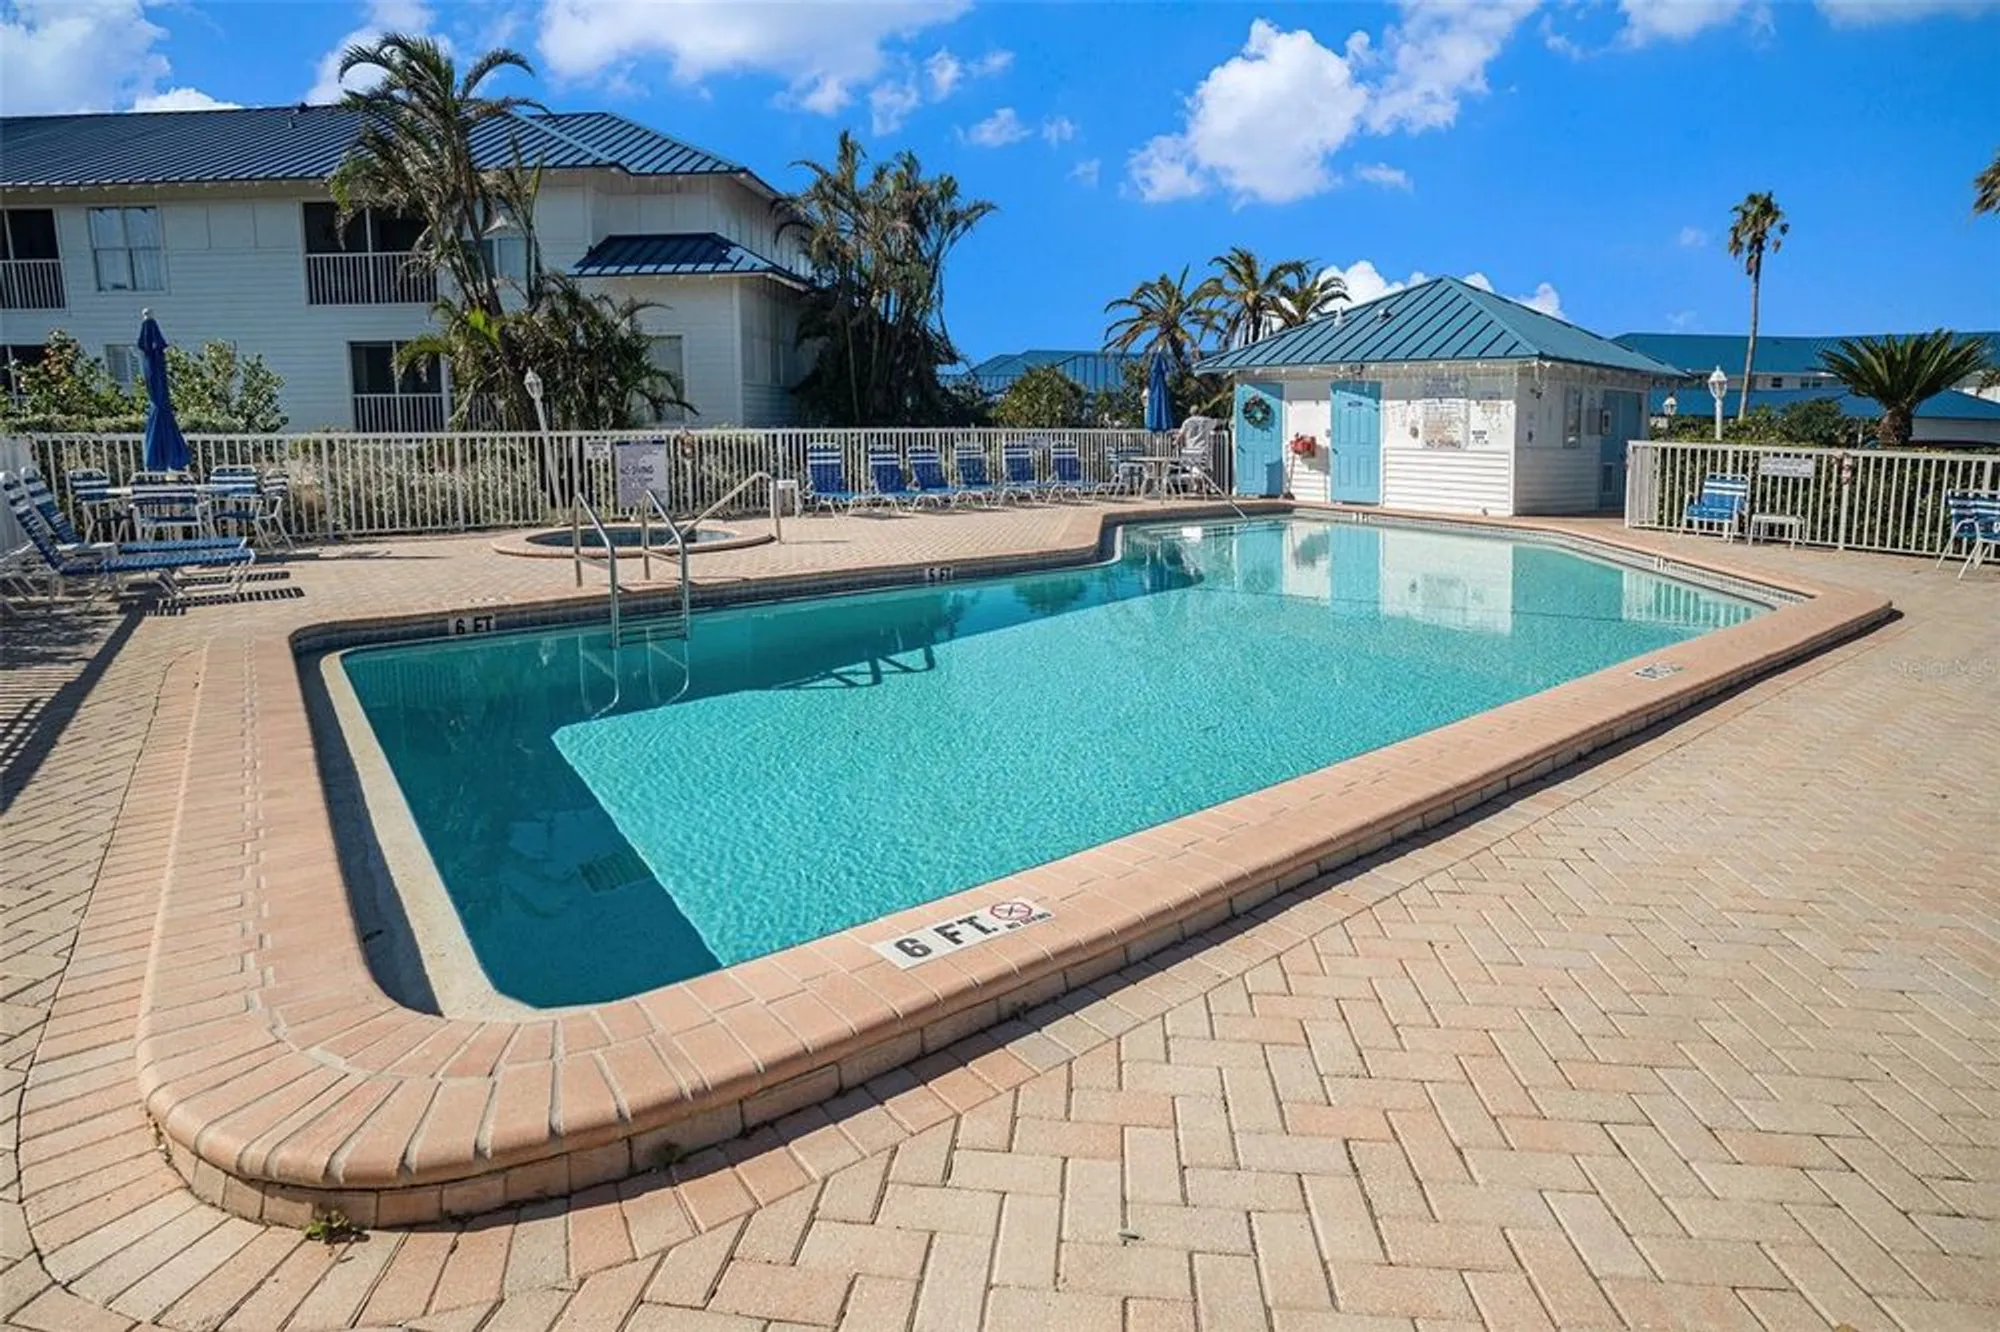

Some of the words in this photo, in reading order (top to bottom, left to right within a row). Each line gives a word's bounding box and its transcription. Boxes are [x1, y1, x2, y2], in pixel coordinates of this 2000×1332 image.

[455, 617, 466, 635] 6
[473, 615, 493, 632] FT
[894, 937, 933, 958] 6
